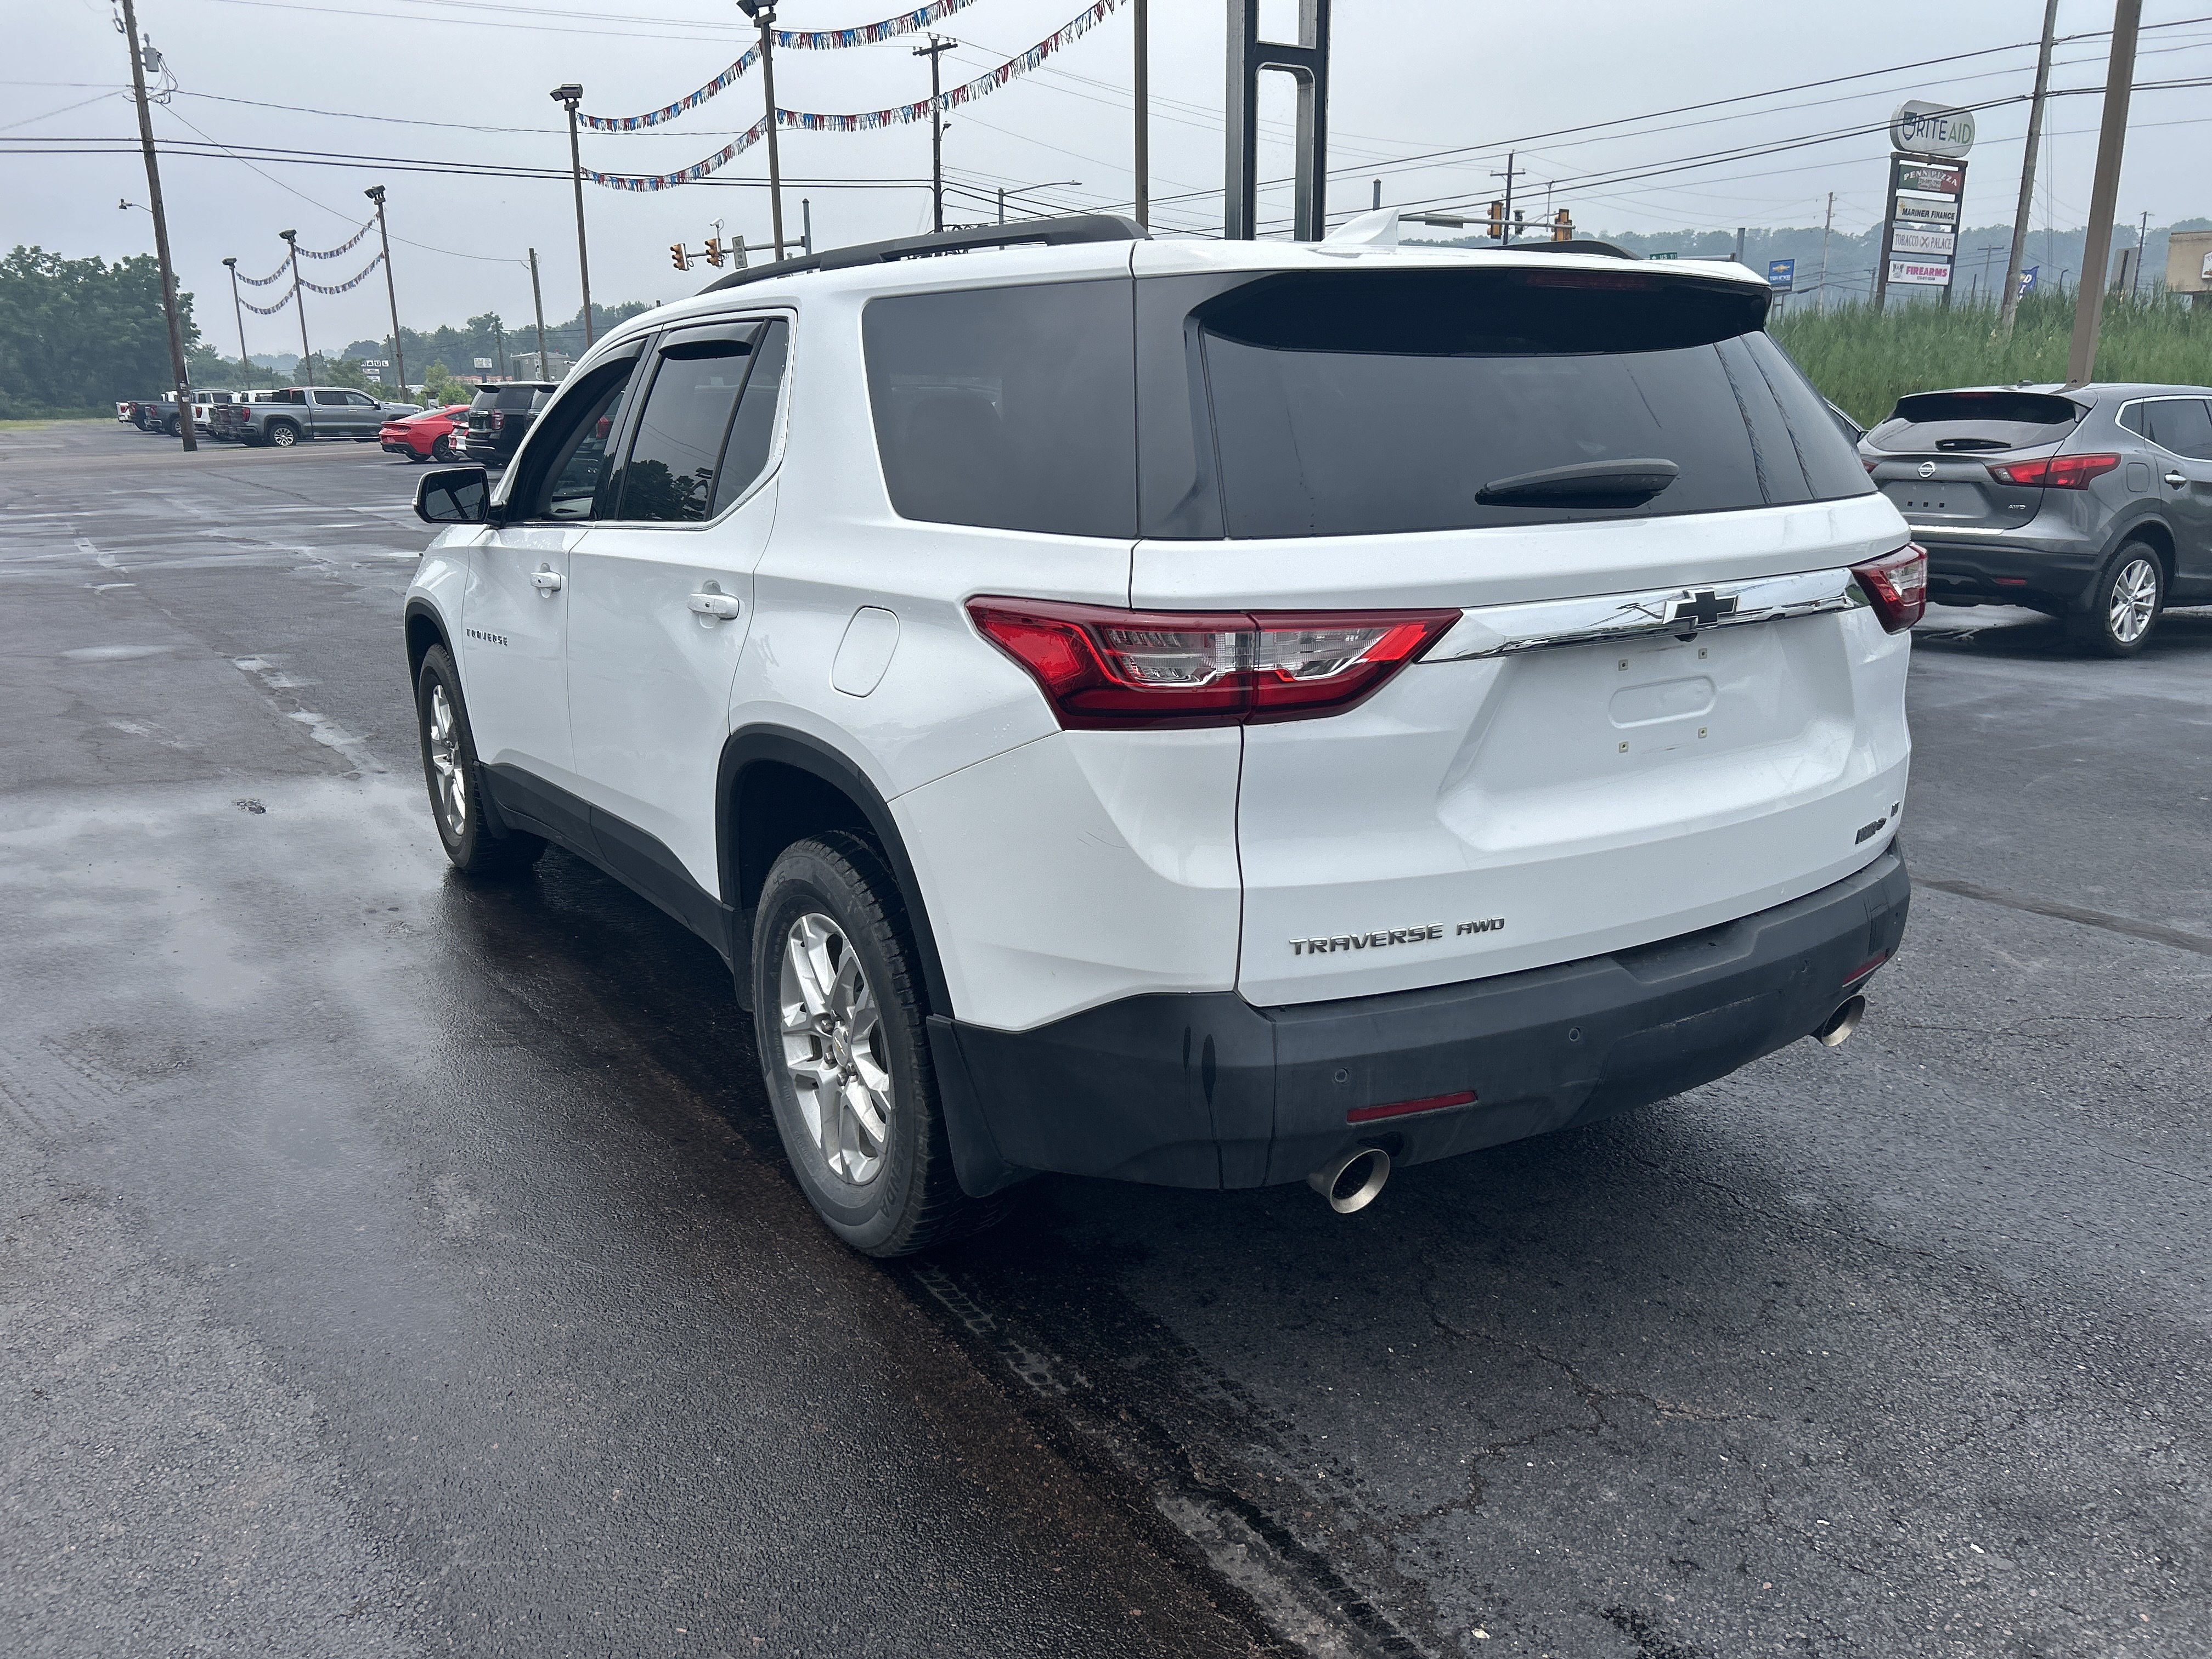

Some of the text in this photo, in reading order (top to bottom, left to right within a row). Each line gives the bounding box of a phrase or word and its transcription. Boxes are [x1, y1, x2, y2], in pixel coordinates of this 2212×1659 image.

[1916, 116, 1971, 144] RITE AID
[1904, 170, 1928, 180] PENN
[1932, 171, 1957, 187] PIZZA
[1902, 208, 1955, 219] MARINER FINANCE
[1895, 234, 1952, 250] TOBACCO PALACE
[1906, 266, 1947, 277] FIREARMS
[1290, 917, 1505, 955] TRAVERSE AWD
